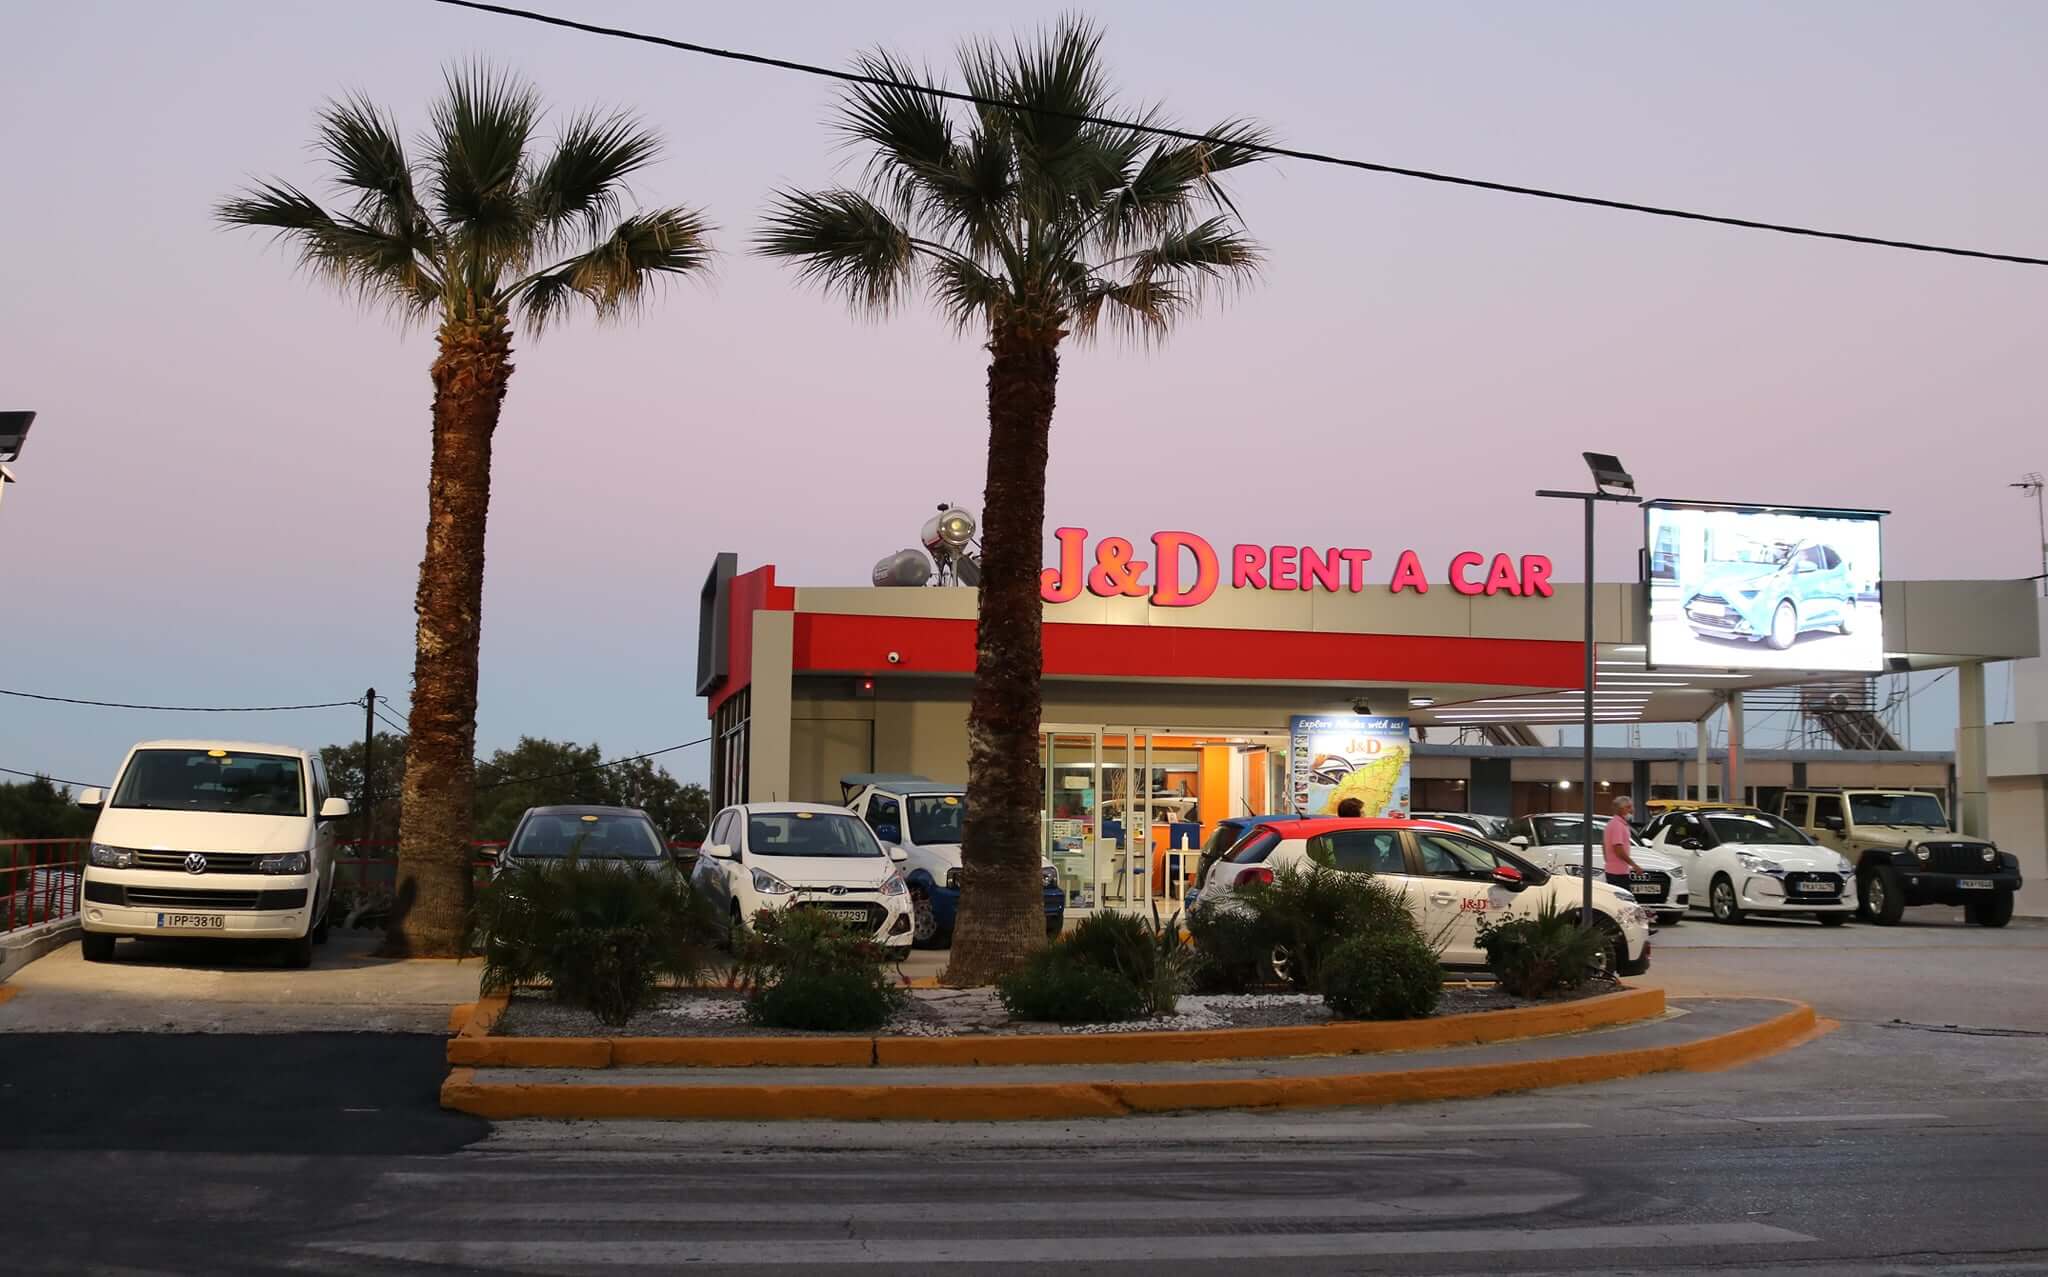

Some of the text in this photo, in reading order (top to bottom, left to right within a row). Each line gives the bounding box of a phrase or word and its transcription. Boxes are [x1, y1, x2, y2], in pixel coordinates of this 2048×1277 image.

[1040, 527, 1554, 607] J&D RENT A CAR
[1368, 719, 1388, 729] with
[1460, 898, 1488, 910] J&D
